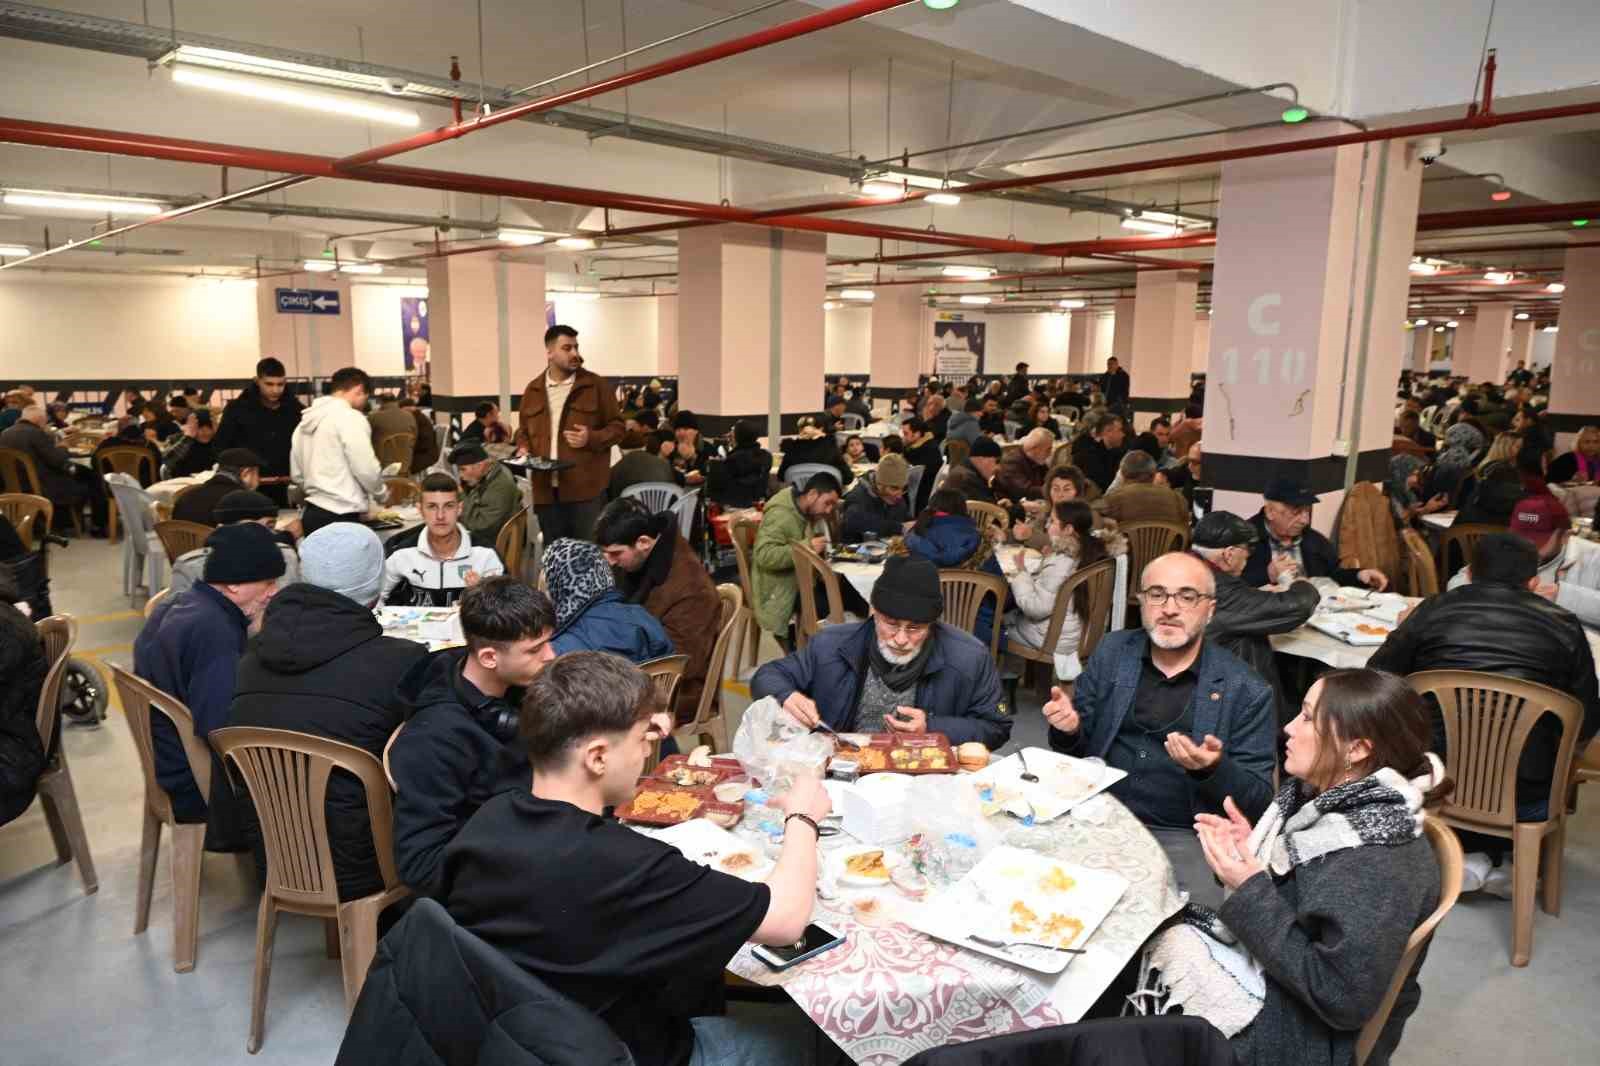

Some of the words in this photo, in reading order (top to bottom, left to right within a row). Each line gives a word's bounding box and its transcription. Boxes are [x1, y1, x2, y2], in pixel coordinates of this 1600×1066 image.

[280, 294, 310, 307] ÇIKIŞ
[1247, 293, 1281, 335] C
[1223, 349, 1307, 384] 110
